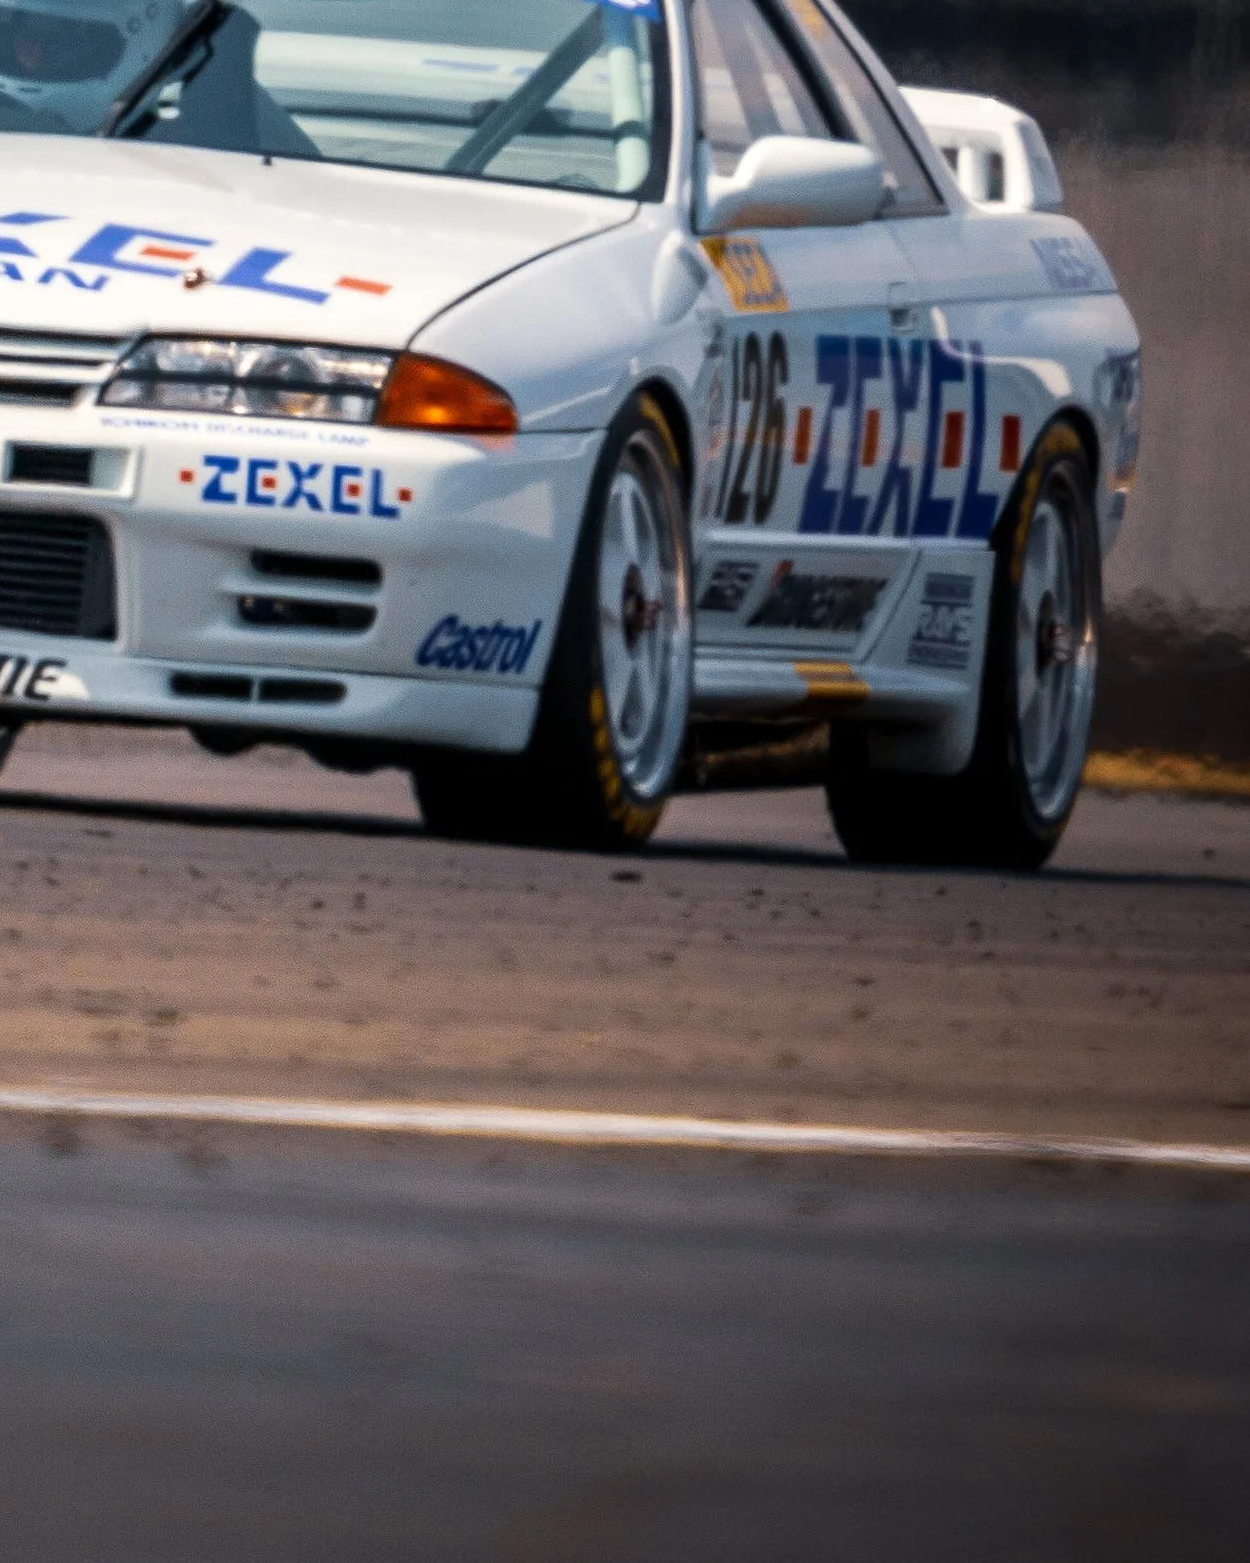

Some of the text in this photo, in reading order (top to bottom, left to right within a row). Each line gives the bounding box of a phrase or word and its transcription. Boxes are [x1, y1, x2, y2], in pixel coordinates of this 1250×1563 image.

[797, 333, 1000, 537] ZEXEL
[200, 454, 402, 520] ZEXEL
[414, 614, 543, 675] Castrol
